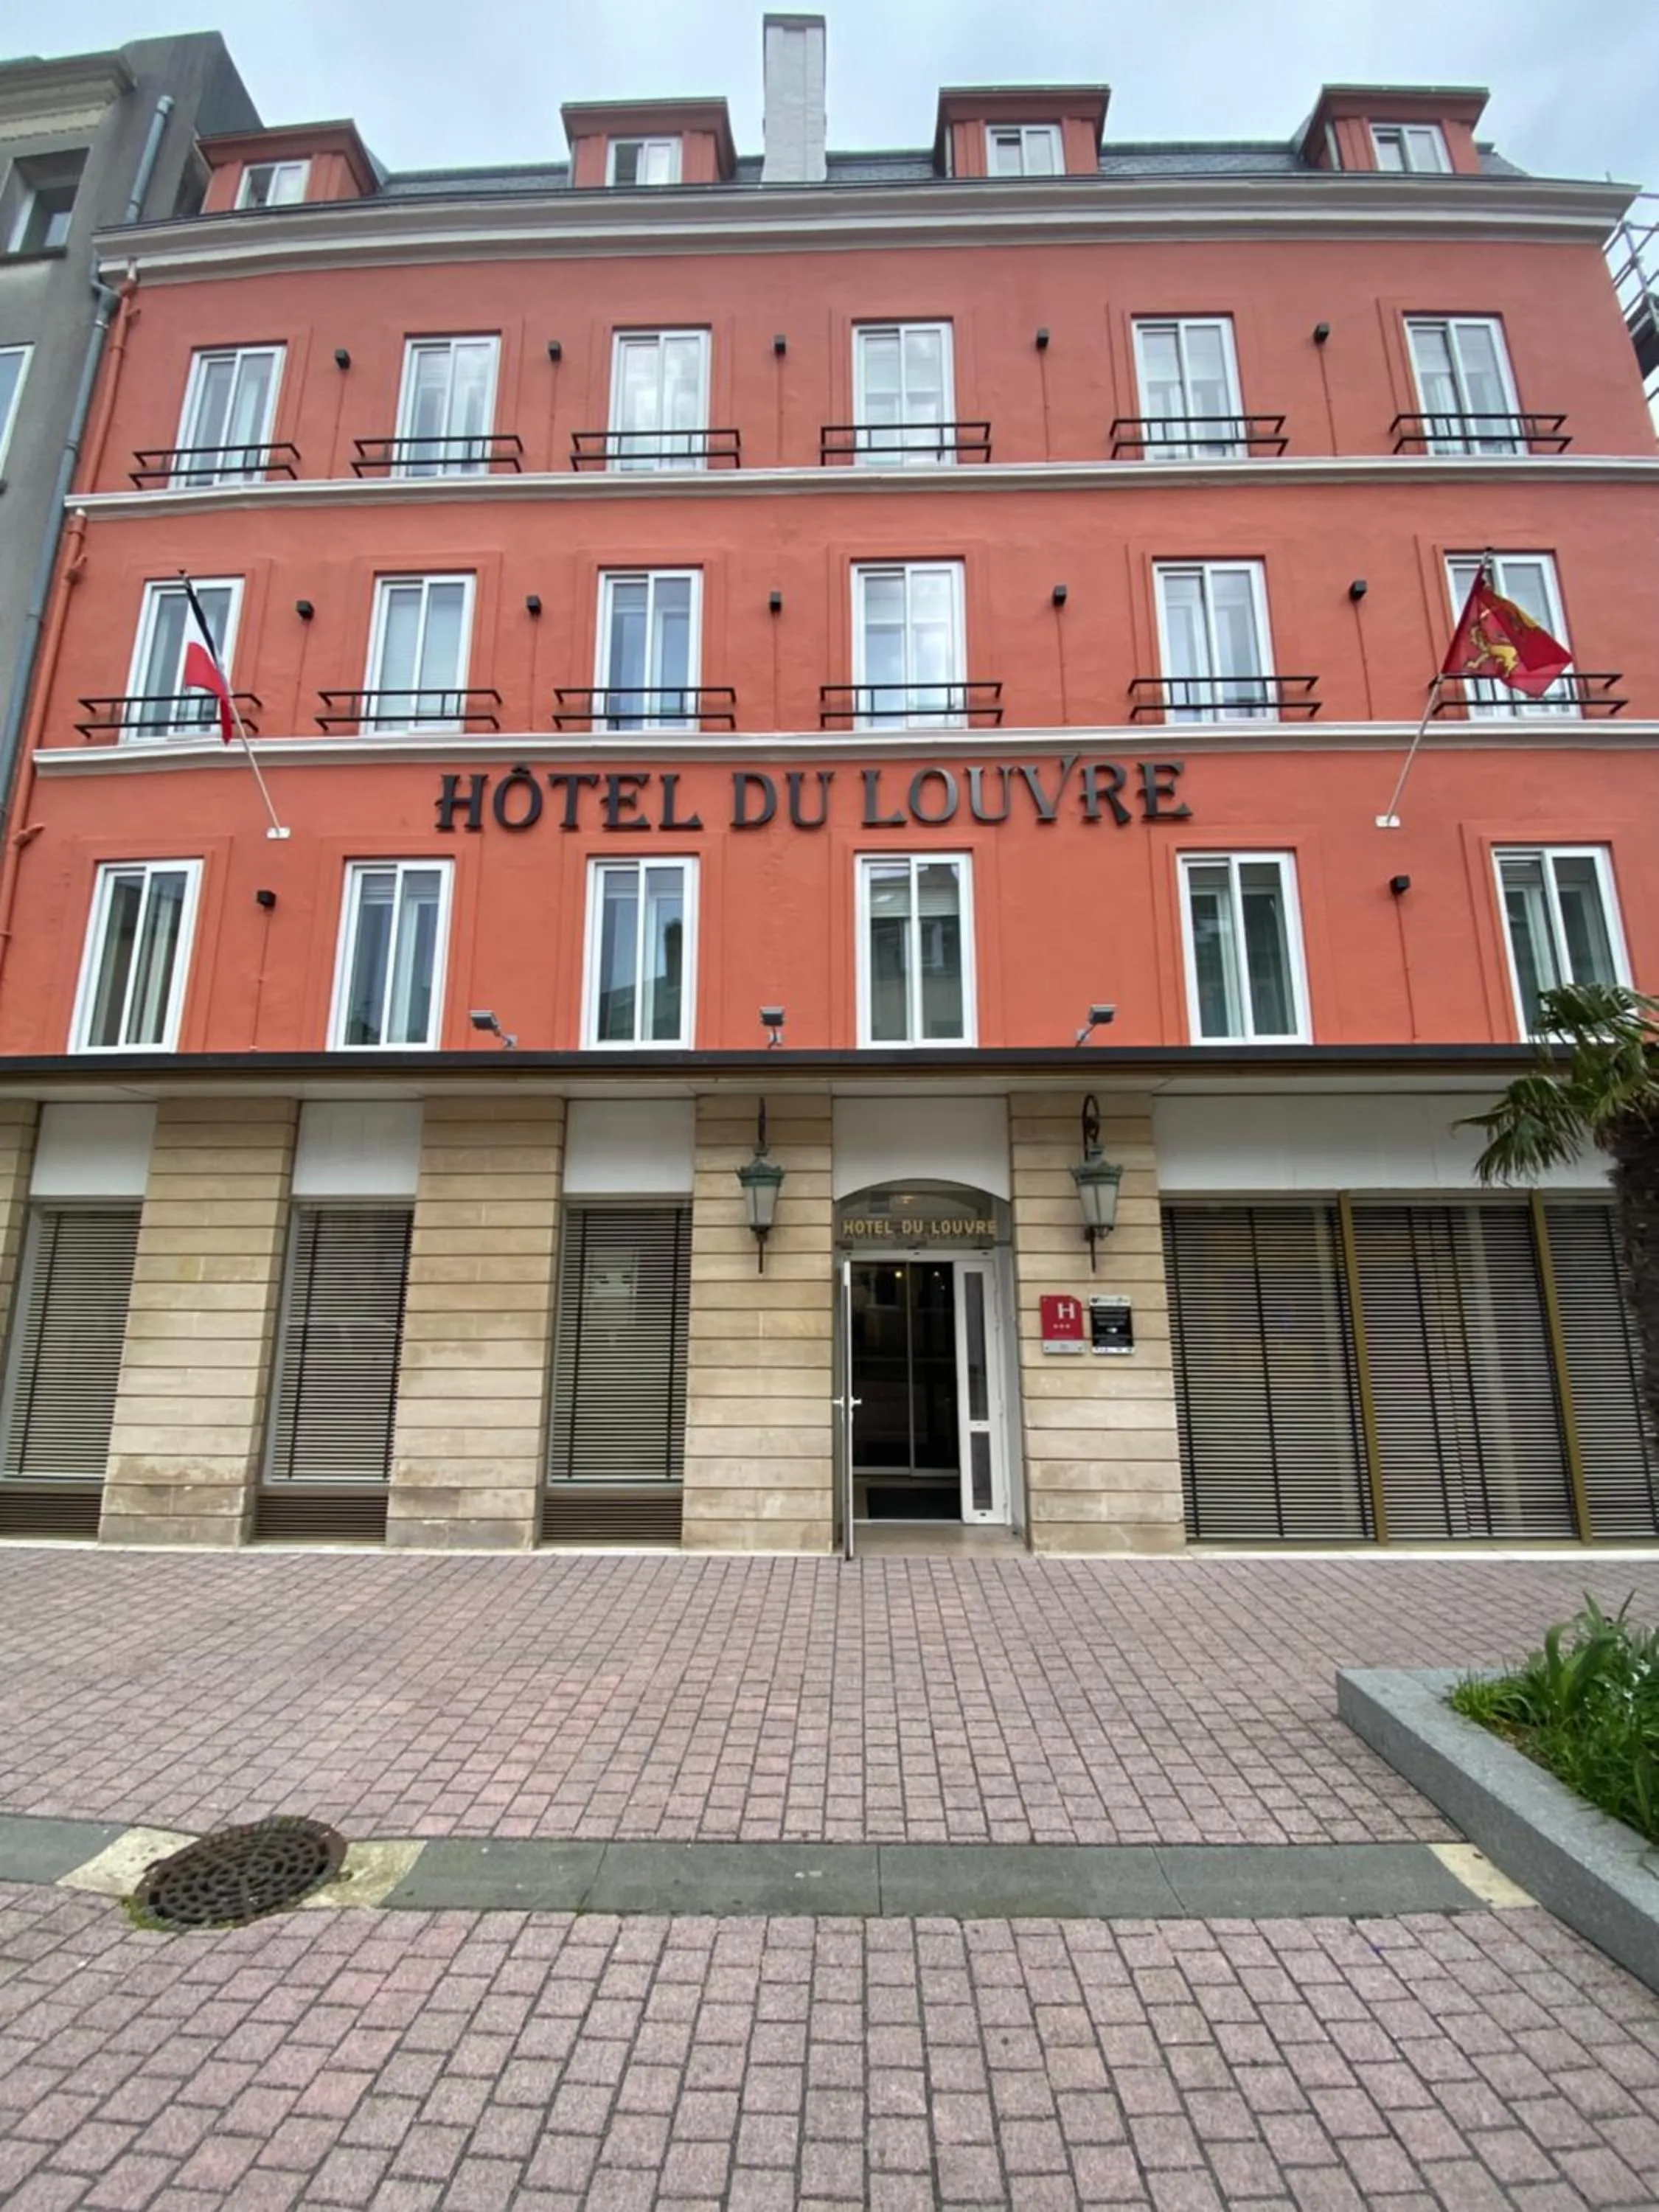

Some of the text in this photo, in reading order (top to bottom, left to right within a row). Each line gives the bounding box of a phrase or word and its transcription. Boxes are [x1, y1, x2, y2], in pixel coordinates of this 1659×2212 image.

[435, 754, 1192, 832] HÔTEL DU LOUVRE
[843, 1220, 997, 1235] HOTEL DU LOUVRE
[1057, 1303, 1074, 1319] H
